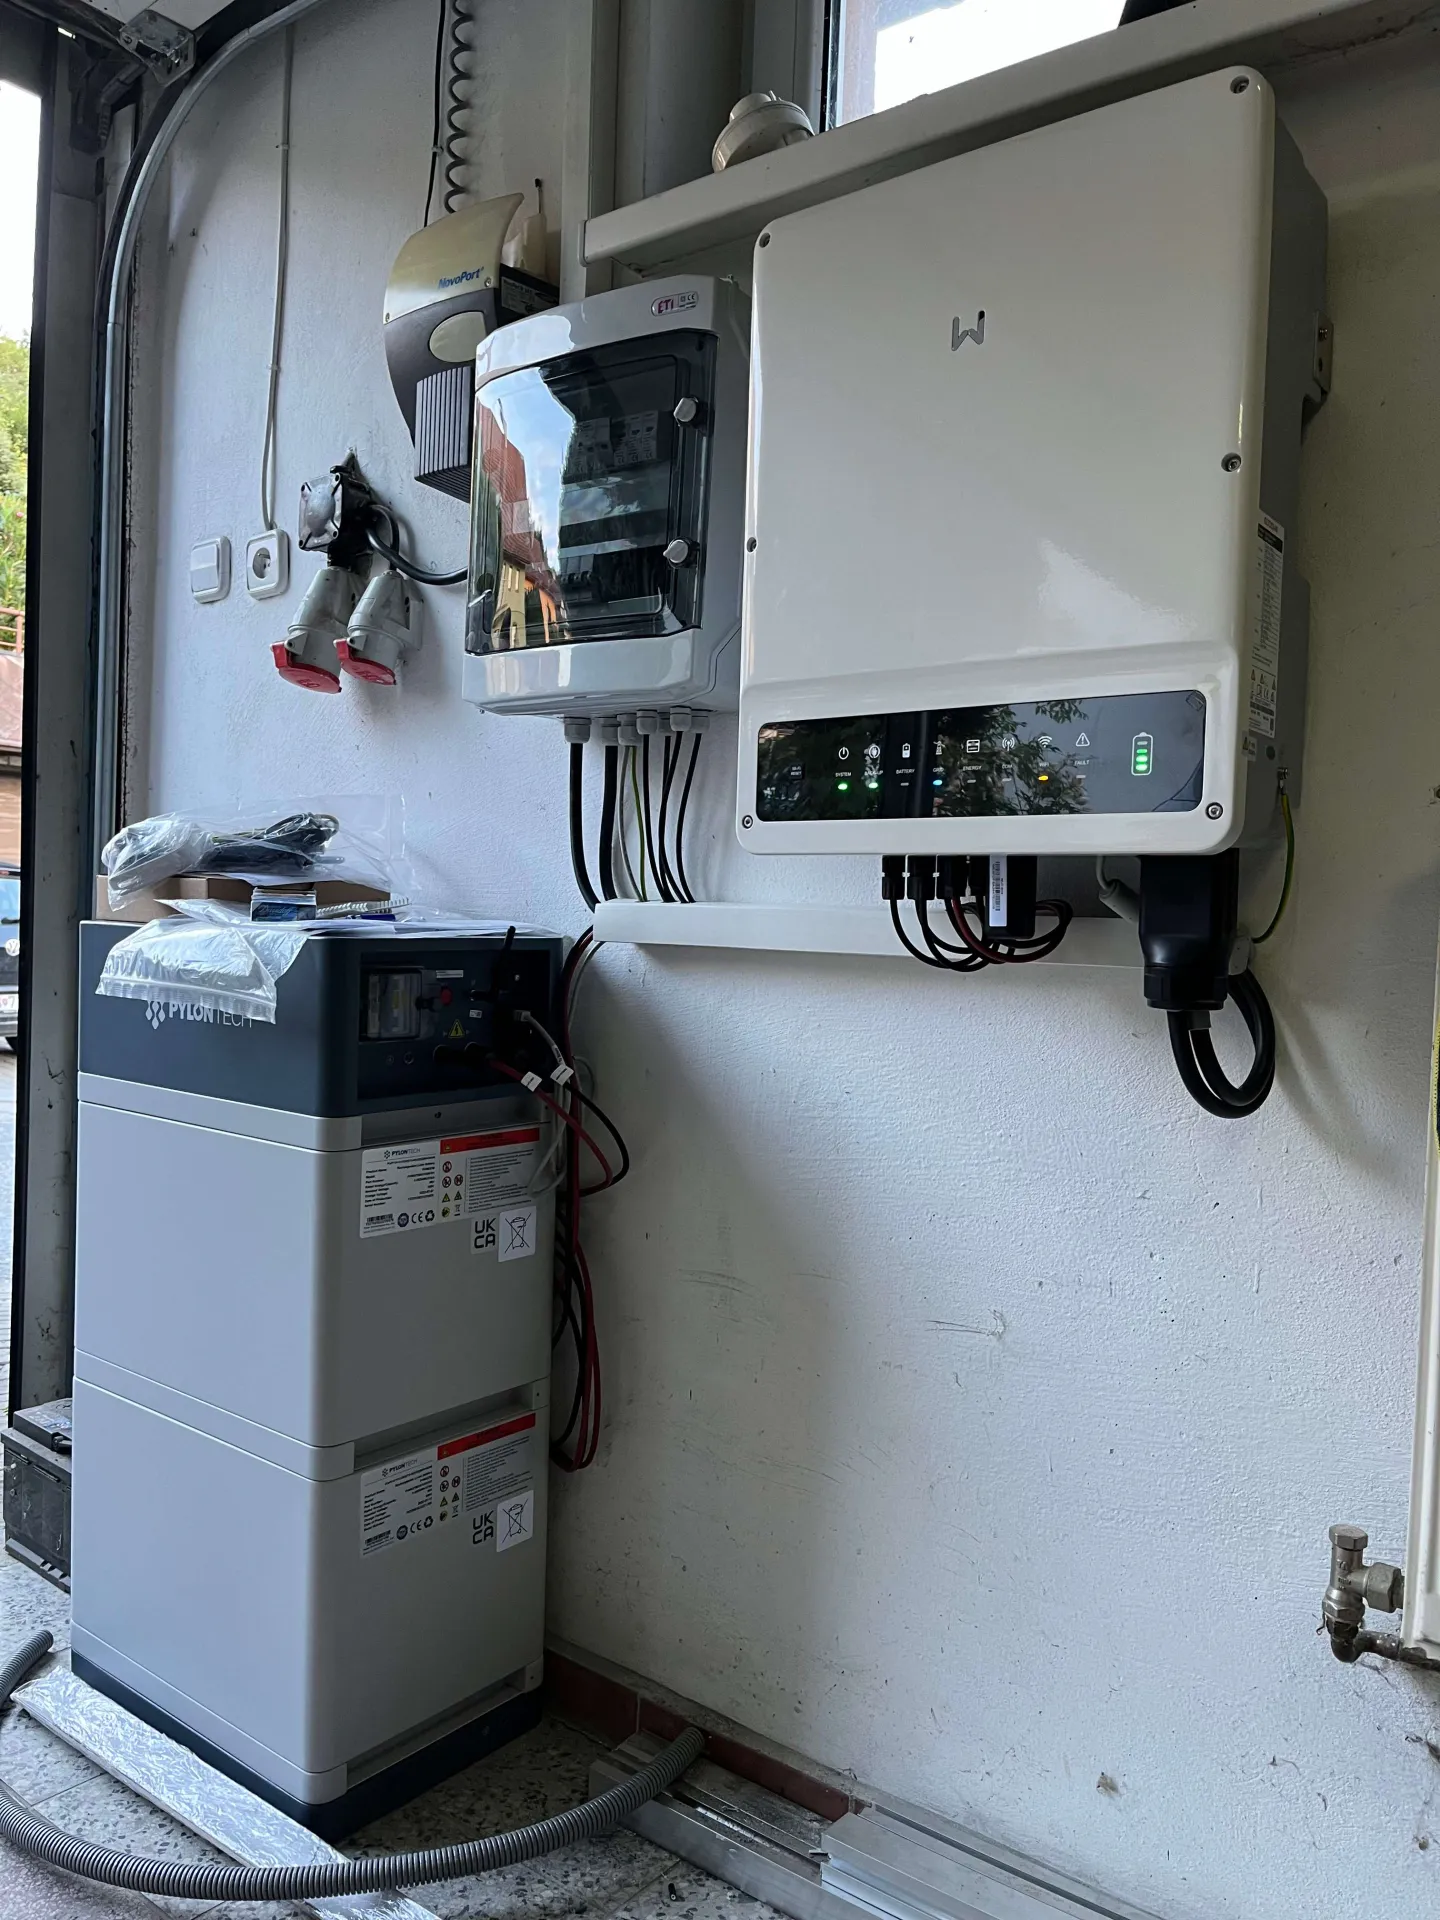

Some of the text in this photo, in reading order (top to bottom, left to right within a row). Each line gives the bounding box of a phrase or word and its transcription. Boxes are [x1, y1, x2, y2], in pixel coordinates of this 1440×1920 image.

[438, 269, 480, 289] NovoPort
[657, 299, 674, 314] ETI
[474, 1218, 497, 1234] UK
[473, 1233, 496, 1249] CA
[472, 1510, 494, 1530] UK
[472, 1526, 494, 1545] CA
